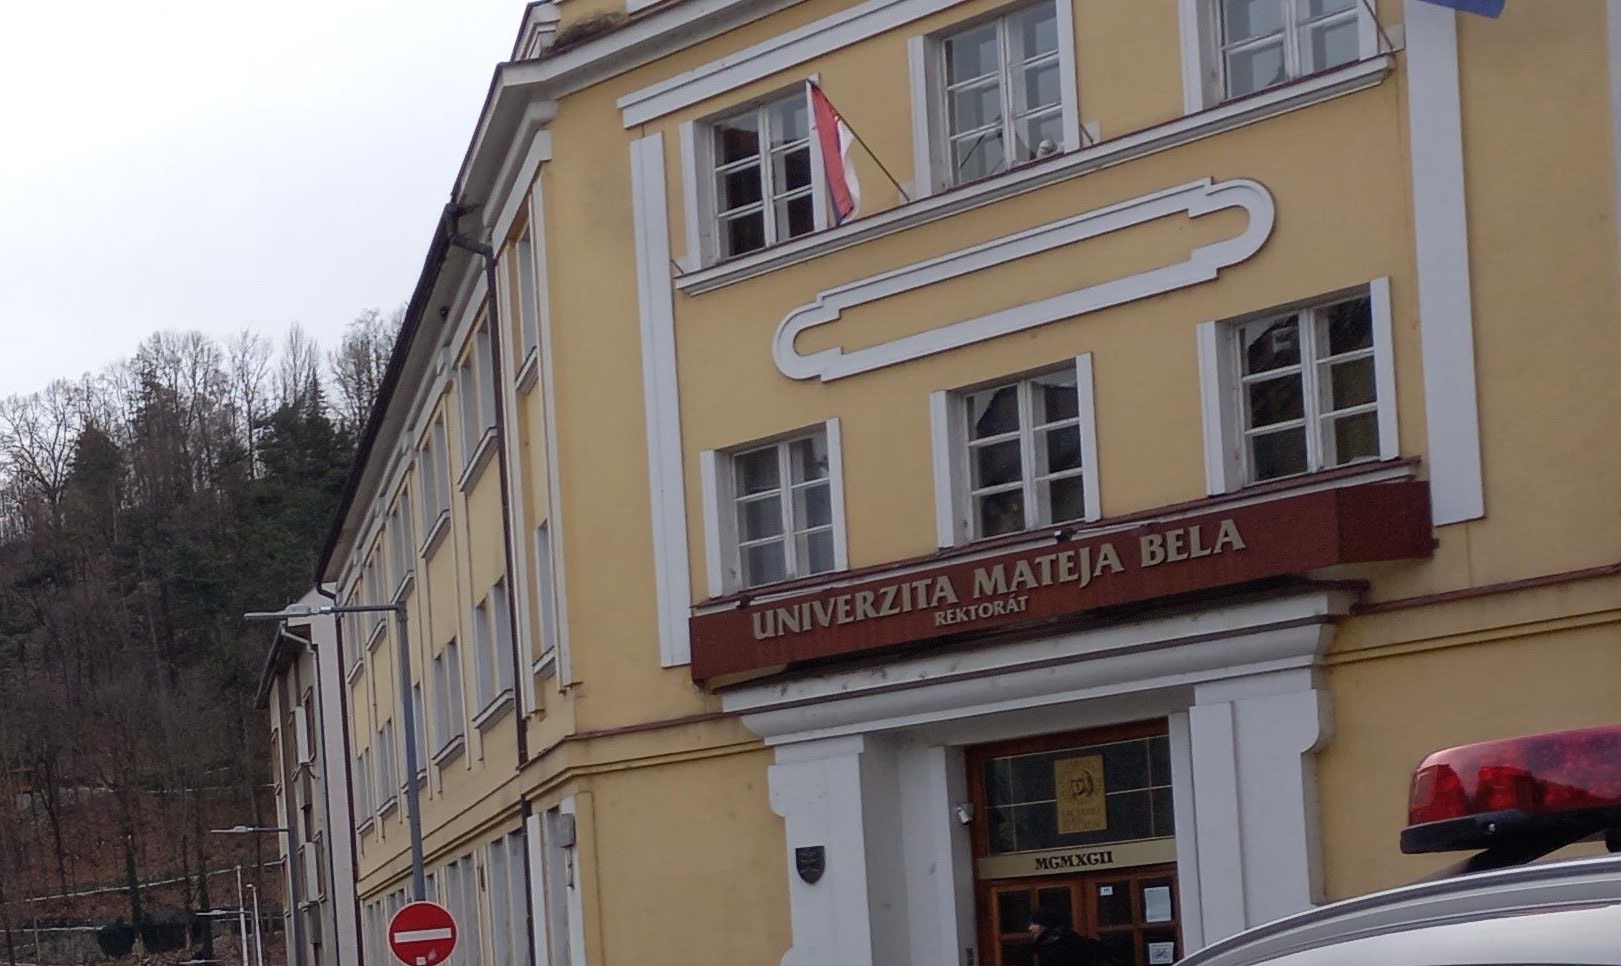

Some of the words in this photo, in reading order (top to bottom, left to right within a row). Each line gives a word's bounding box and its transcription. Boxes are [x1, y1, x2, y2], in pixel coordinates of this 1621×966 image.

[751, 575, 960, 641] UNIVERZITA
[972, 543, 1125, 598] MATEJA
[1139, 518, 1247, 569] BELA
[934, 593, 1030, 627] REKTORÁT
